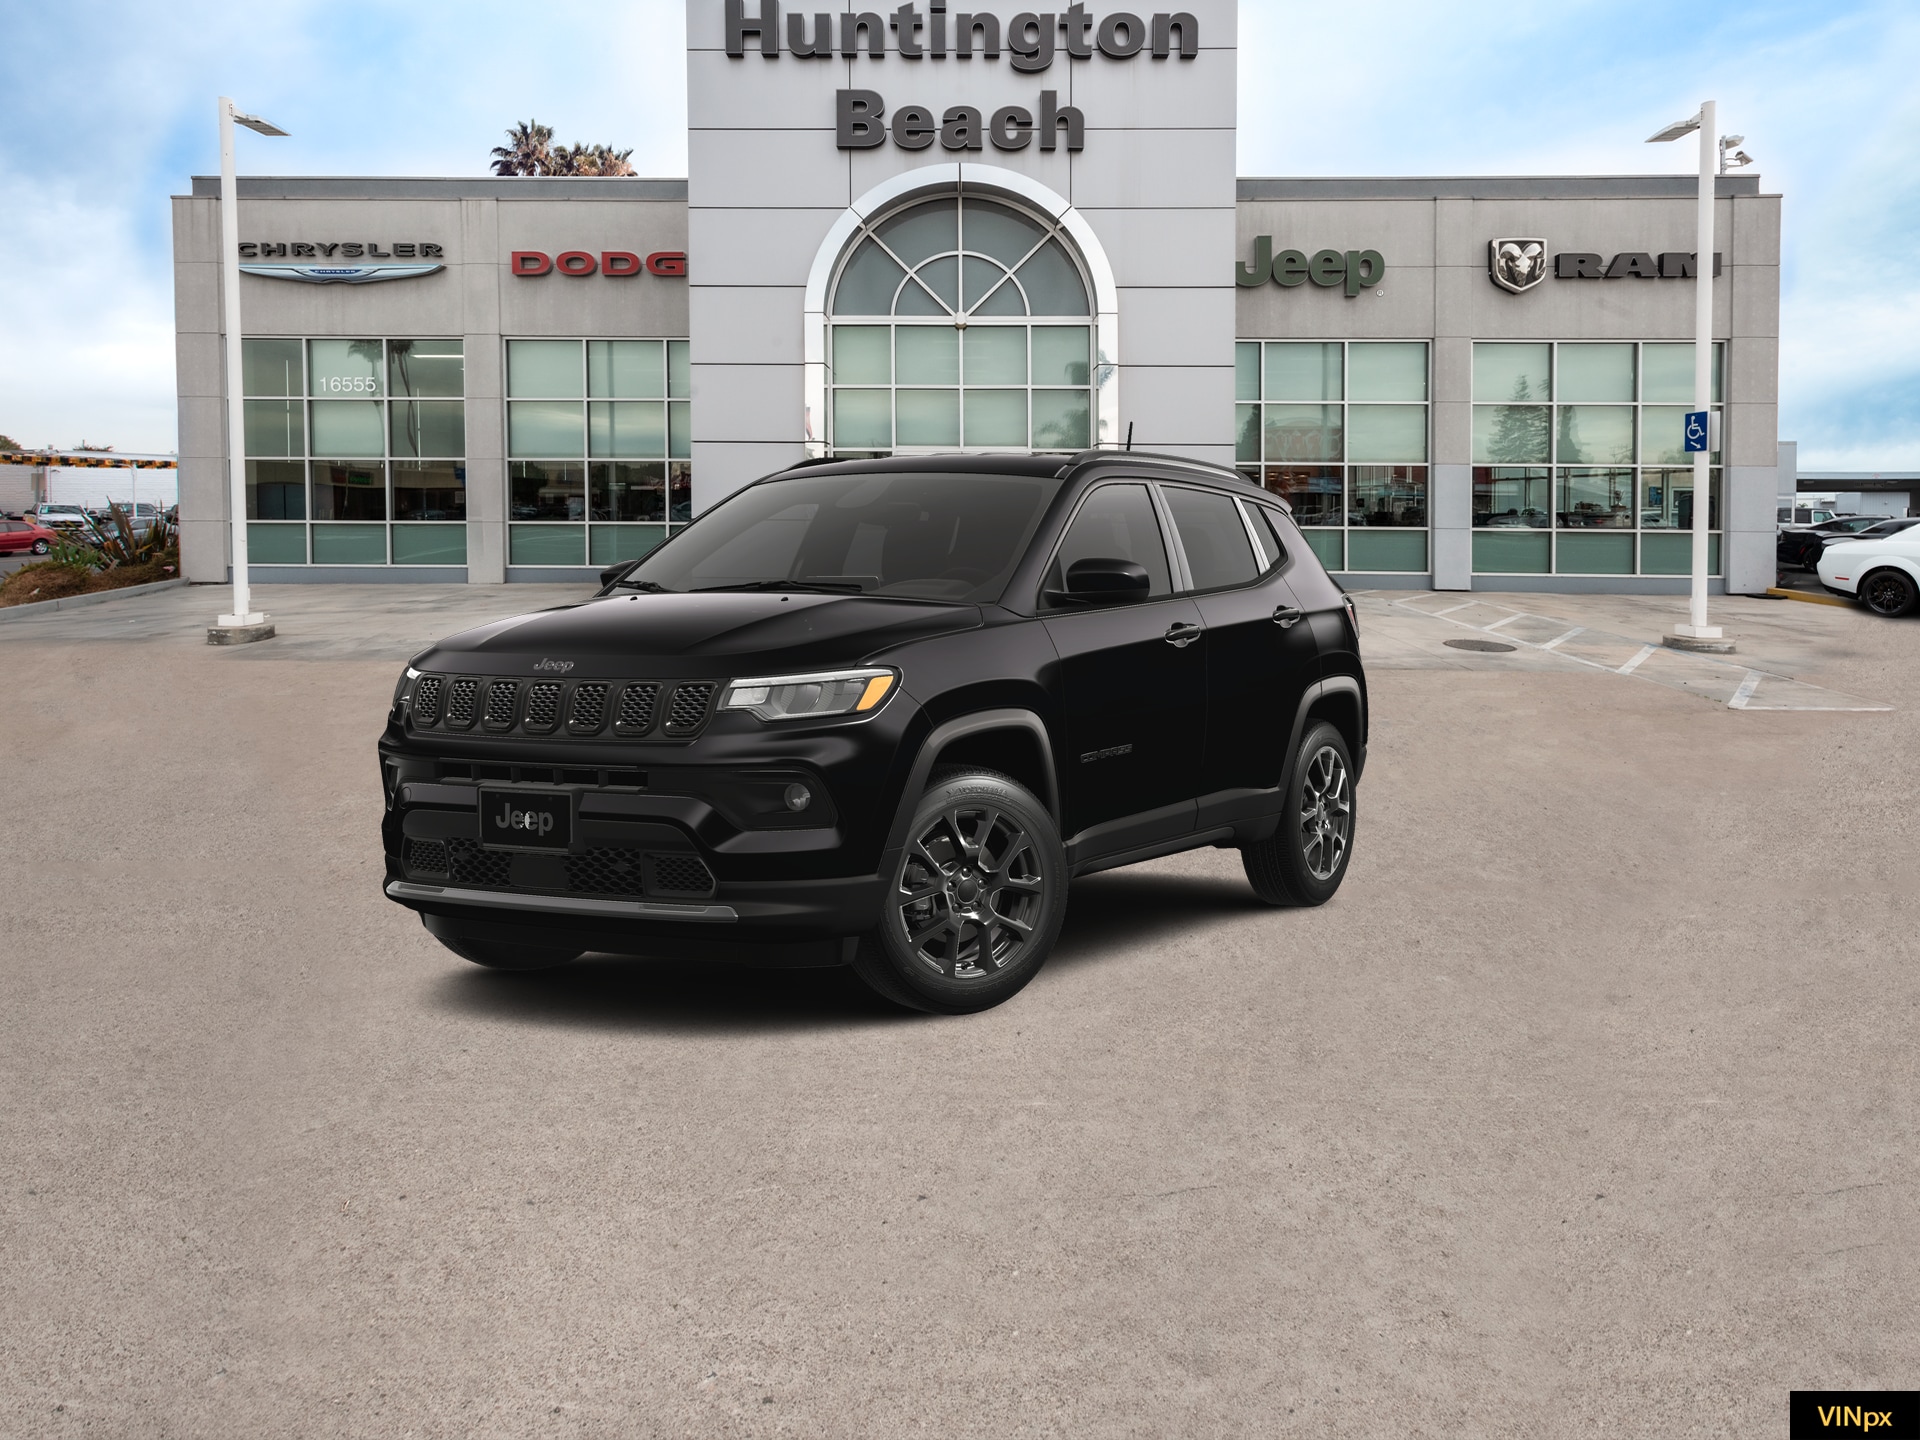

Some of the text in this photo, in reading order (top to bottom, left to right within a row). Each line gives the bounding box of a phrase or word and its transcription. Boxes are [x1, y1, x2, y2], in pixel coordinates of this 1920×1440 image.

[725, 0, 1199, 74] Huntington
[836, 89, 1084, 152] Beach
[239, 242, 444, 258] CHRYSLER
[1555, 252, 1722, 279] RAM
[1235, 235, 1385, 298] Jeep
[319, 376, 377, 392] 16555
[533, 657, 575, 673] Jeep
[495, 802, 554, 837] Jeep
